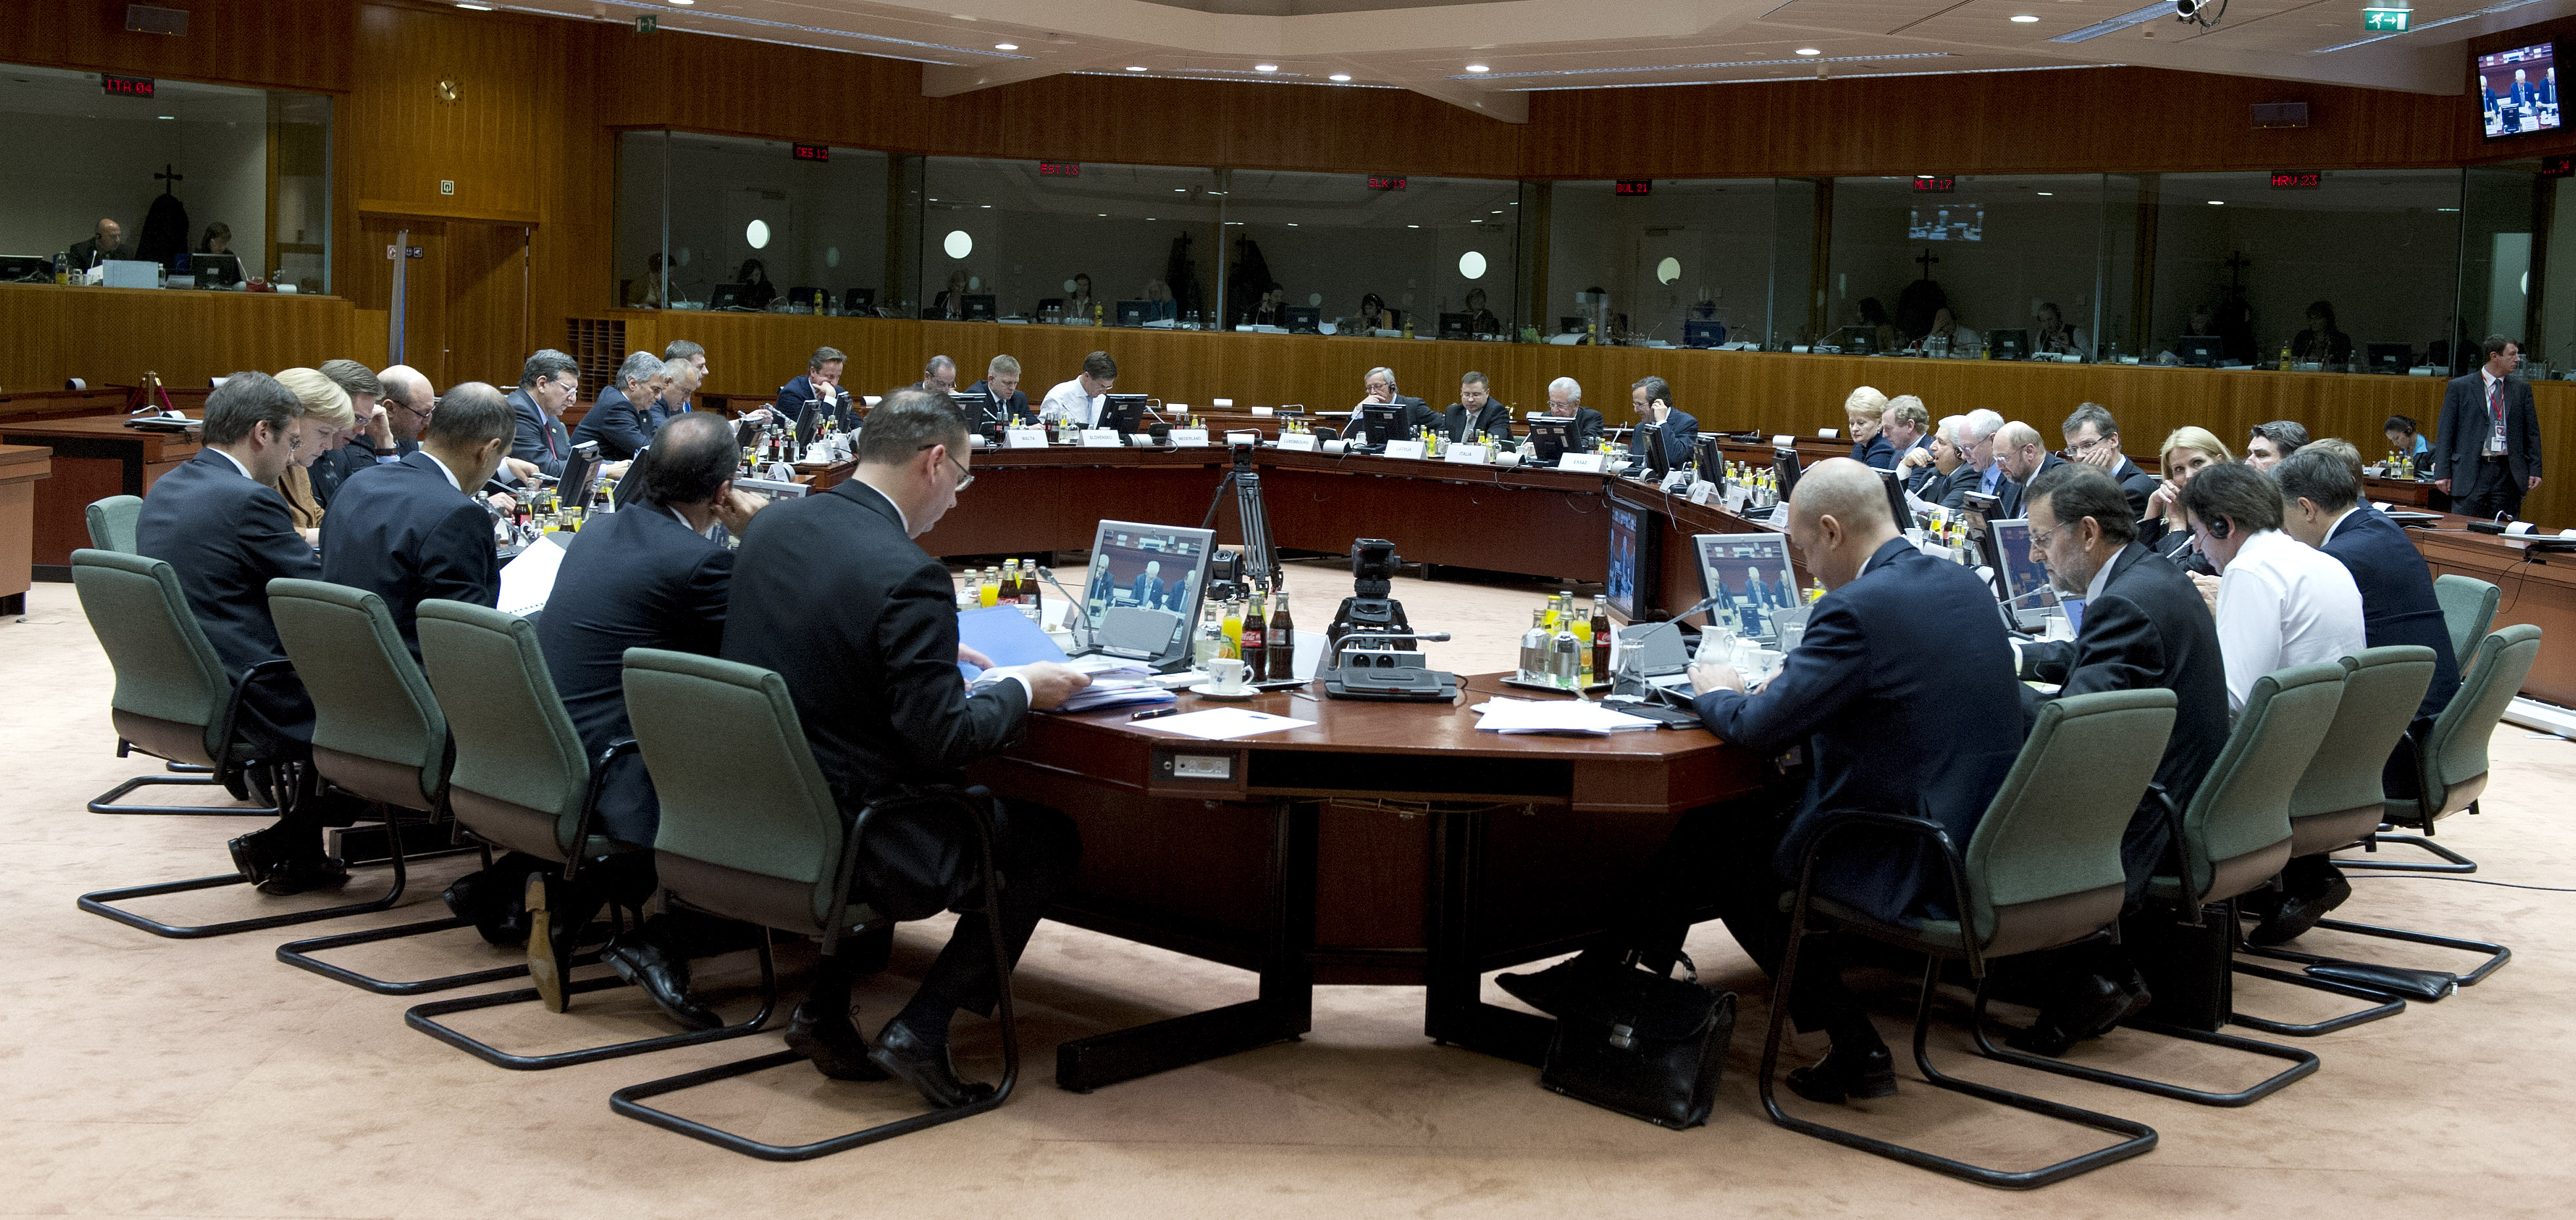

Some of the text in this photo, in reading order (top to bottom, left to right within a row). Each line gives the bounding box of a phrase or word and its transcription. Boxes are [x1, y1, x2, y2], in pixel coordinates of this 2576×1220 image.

[106, 79, 153, 94] ITA 04
[797, 147, 828, 159] CES 12
[1041, 164, 1079, 175] EST 13
[1369, 178, 1406, 188] SLK 19
[1915, 180, 1953, 190] MLT 17
[2272, 174, 2317, 186] HRV 23
[1616, 184, 1647, 193] BUL 21
